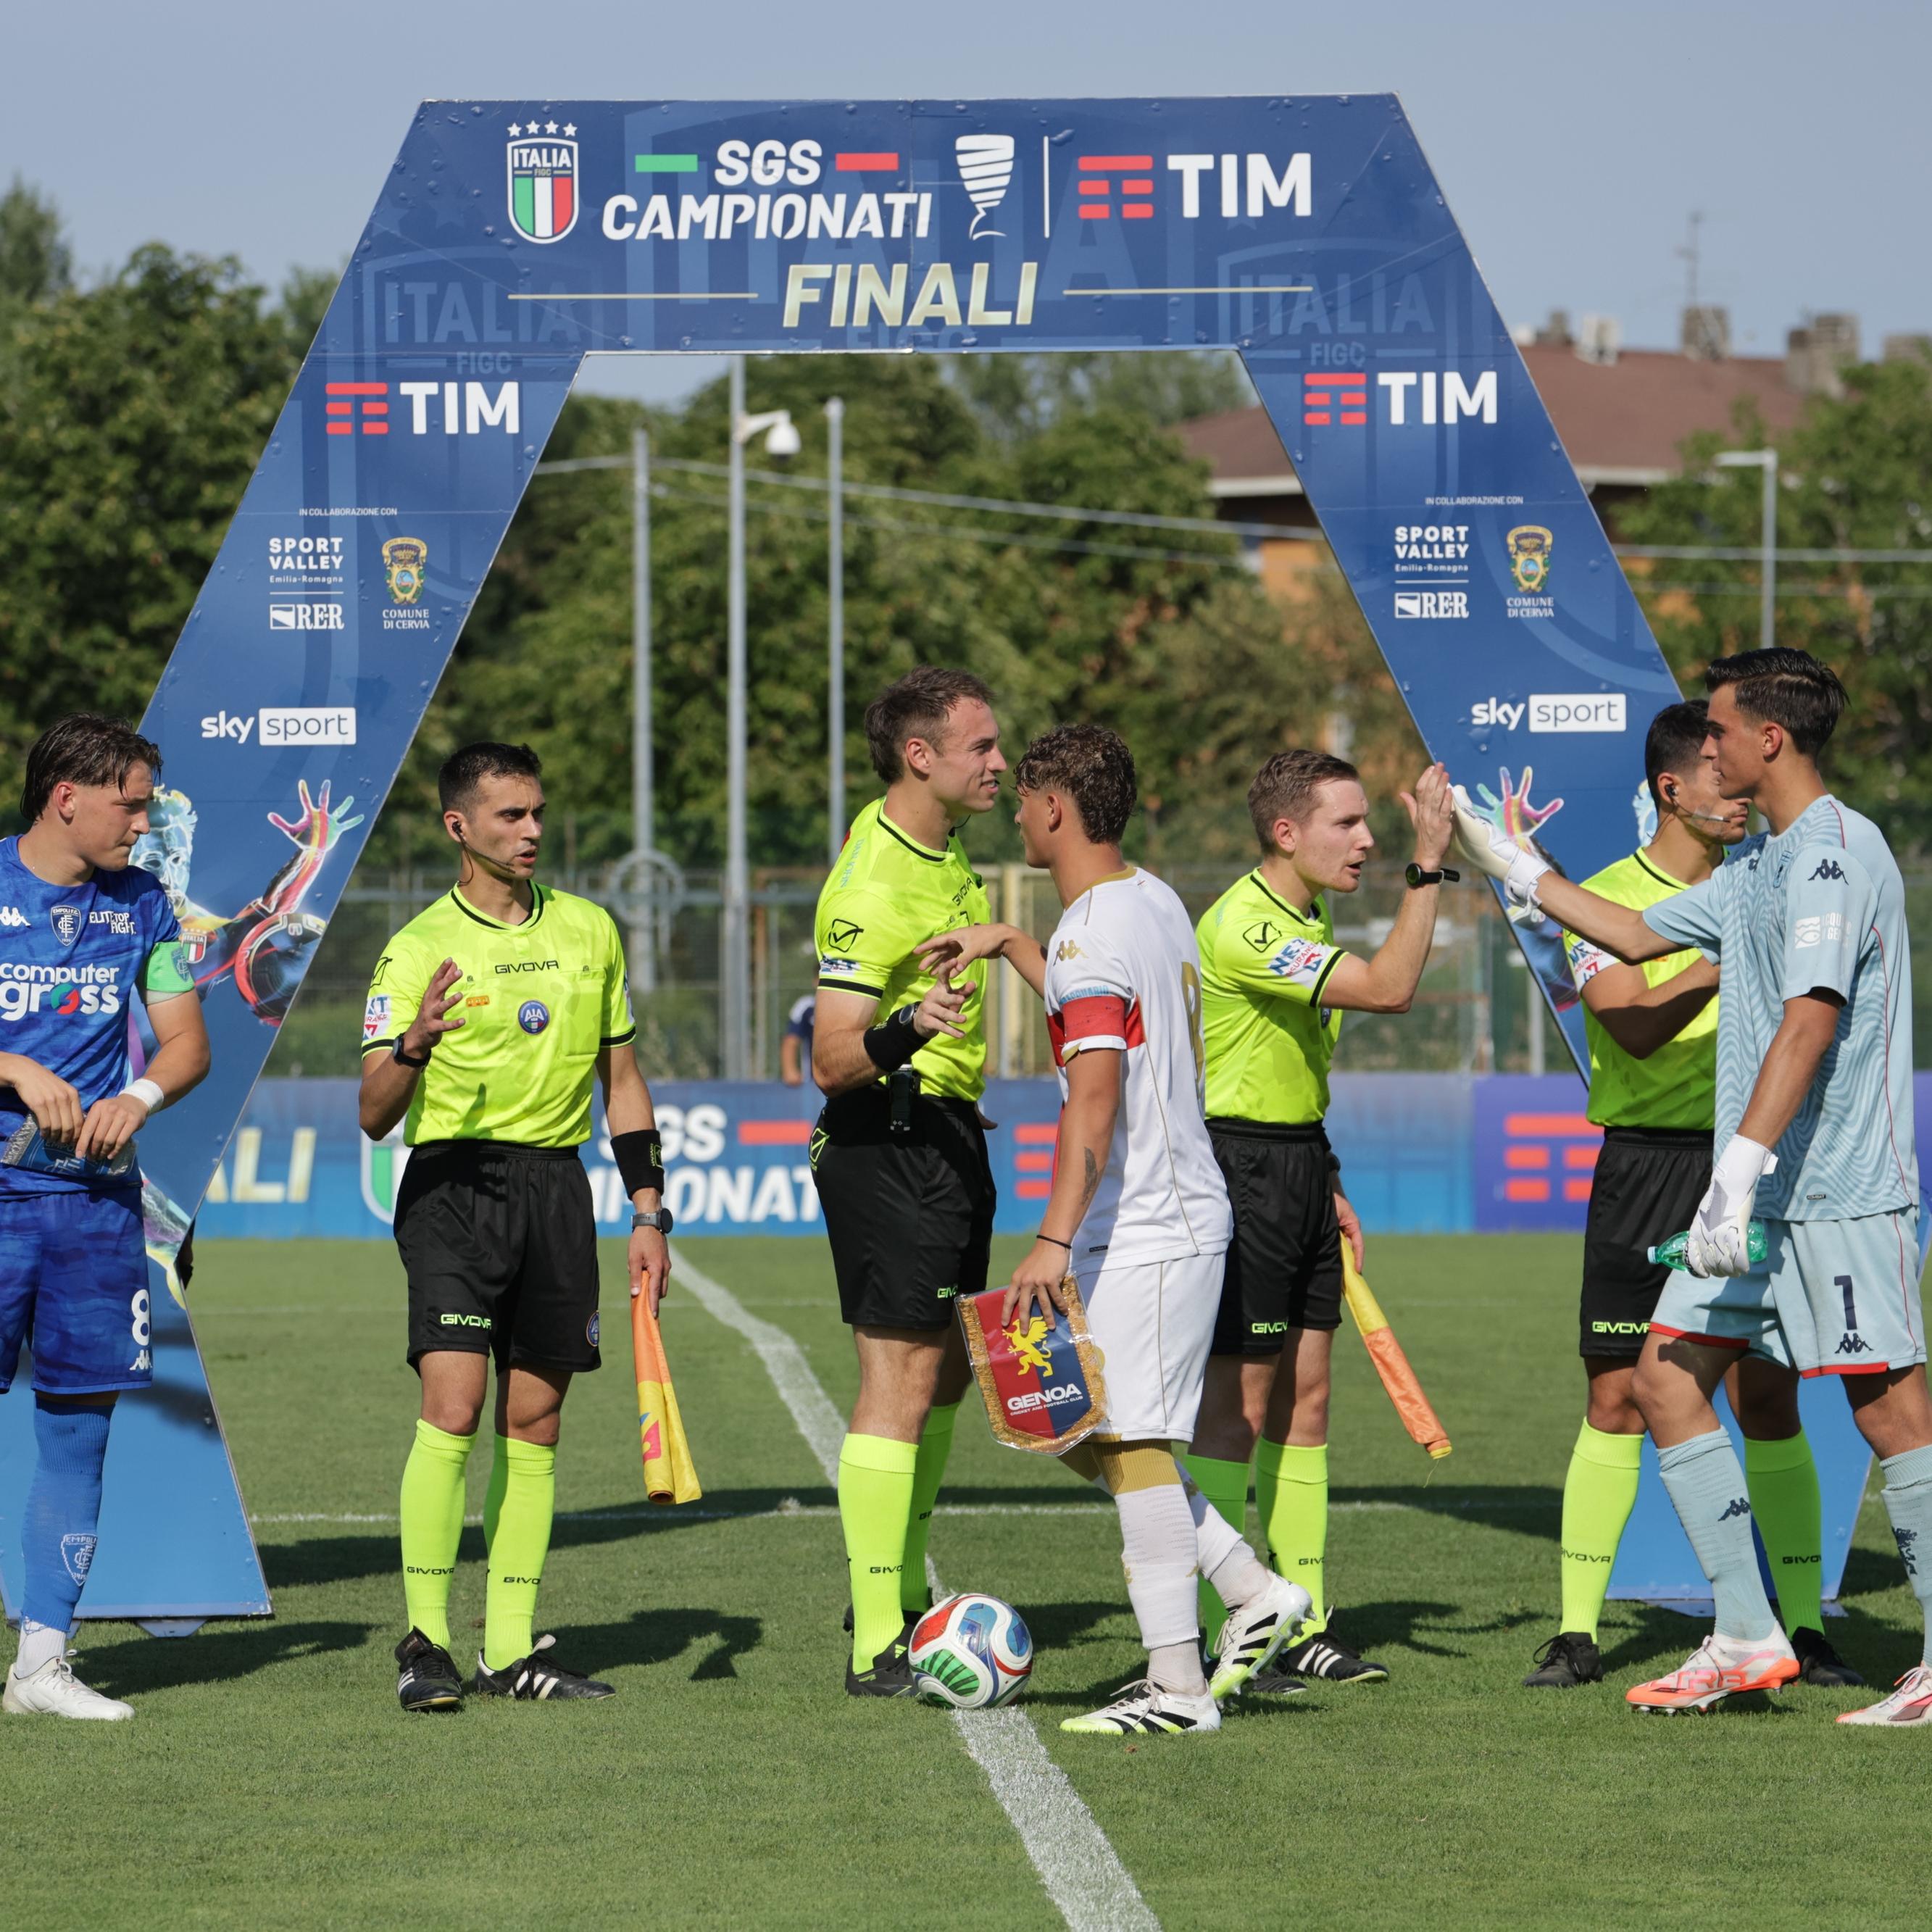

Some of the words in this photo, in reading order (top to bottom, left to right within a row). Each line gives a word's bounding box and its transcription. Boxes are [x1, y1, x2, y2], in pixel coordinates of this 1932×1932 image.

[513, 148, 572, 167] ITALIA
[715, 139, 822, 186] SGS
[1167, 153, 1312, 217] TIM
[602, 193, 933, 240] CAMPIONATI
[783, 262, 1038, 328] FINALI
[1238, 273, 1436, 334] ITALIA
[385, 282, 579, 343] ITALIA
[457, 351, 512, 374] FIGC
[399, 381, 520, 435] TIM
[1378, 371, 1497, 425] TIM
[1435, 496, 1504, 505] COLLABORAZIONE
[270, 538, 343, 553] SPORT
[1395, 526, 1468, 541] SPORT
[269, 555, 343, 570] VALLEY
[1395, 544, 1469, 559] VALLEY
[1395, 564, 1468, 572] Emilia-Romagna
[383, 609, 429, 618] COMUNE
[1421, 593, 1469, 618] RER
[1507, 597, 1554, 607] COMUNE
[1508, 608, 1518, 617] DI
[1520, 607, 1554, 617] CERVIA
[296, 604, 344, 629] RER
[384, 620, 394, 629] DI
[396, 620, 430, 629] CERVIA
[1471, 698, 1525, 730] sky
[1536, 700, 1618, 727] sport
[201, 711, 254, 744] sky
[267, 714, 349, 740] sport
[0, 963, 120, 984] computer
[494, 960, 559, 974] GIVOVA
[1833, 1275, 1857, 1331] 1
[131, 1290, 149, 1346] 8
[1007, 1383, 1082, 1411] GENOA
[1044, 1399, 1069, 1409] FOOTBALL
